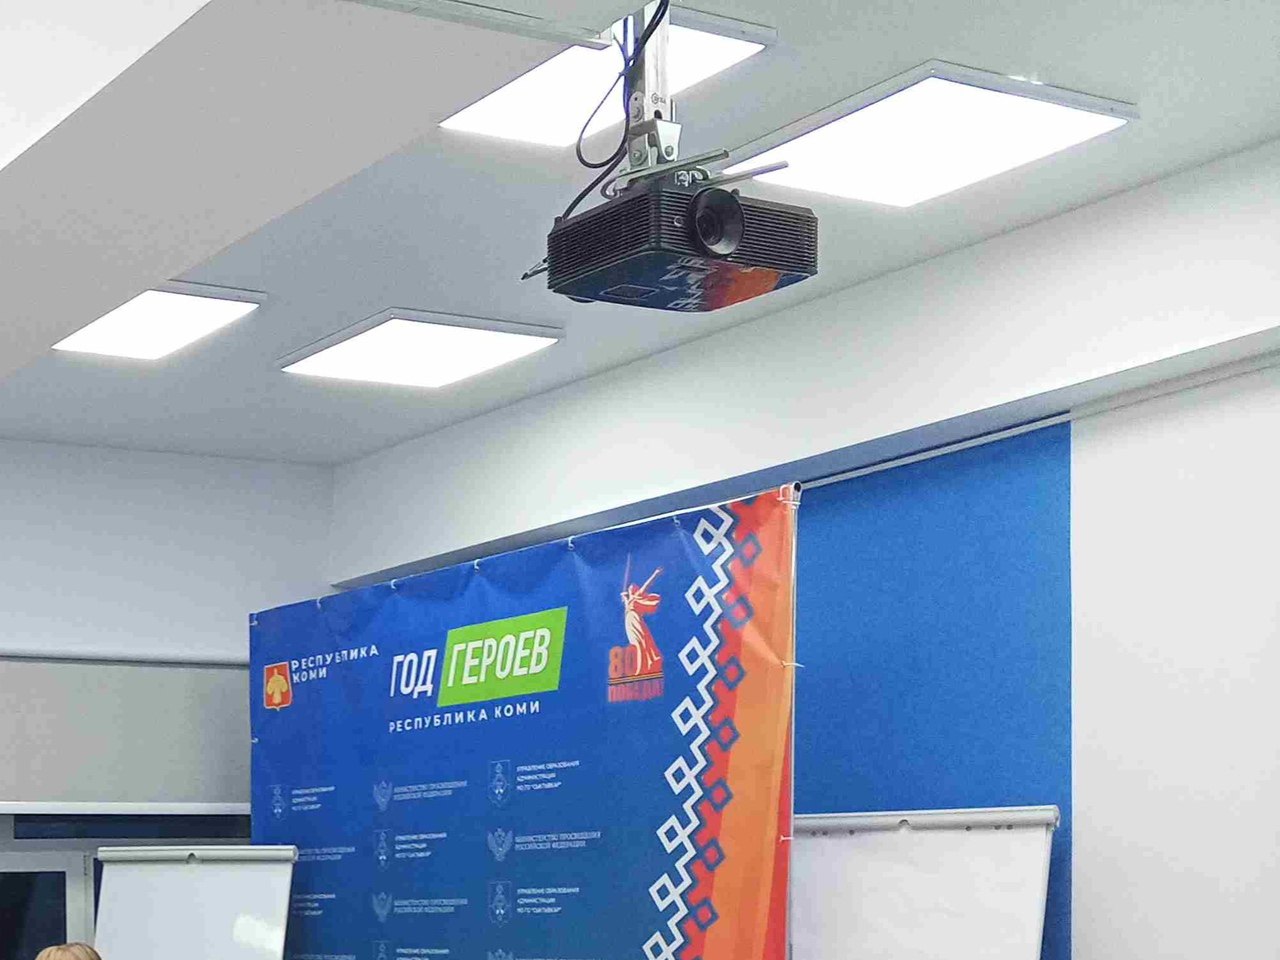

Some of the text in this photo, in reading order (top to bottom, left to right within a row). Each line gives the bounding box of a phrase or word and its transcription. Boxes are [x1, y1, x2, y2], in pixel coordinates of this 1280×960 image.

[291, 644, 380, 671] РЕСПУБЛИКА
[389, 628, 552, 700] ГОД ГЕРОЕВ
[293, 667, 328, 683] КОМИ
[389, 700, 541, 734] РЕСПУБЛИКА КОМИ
